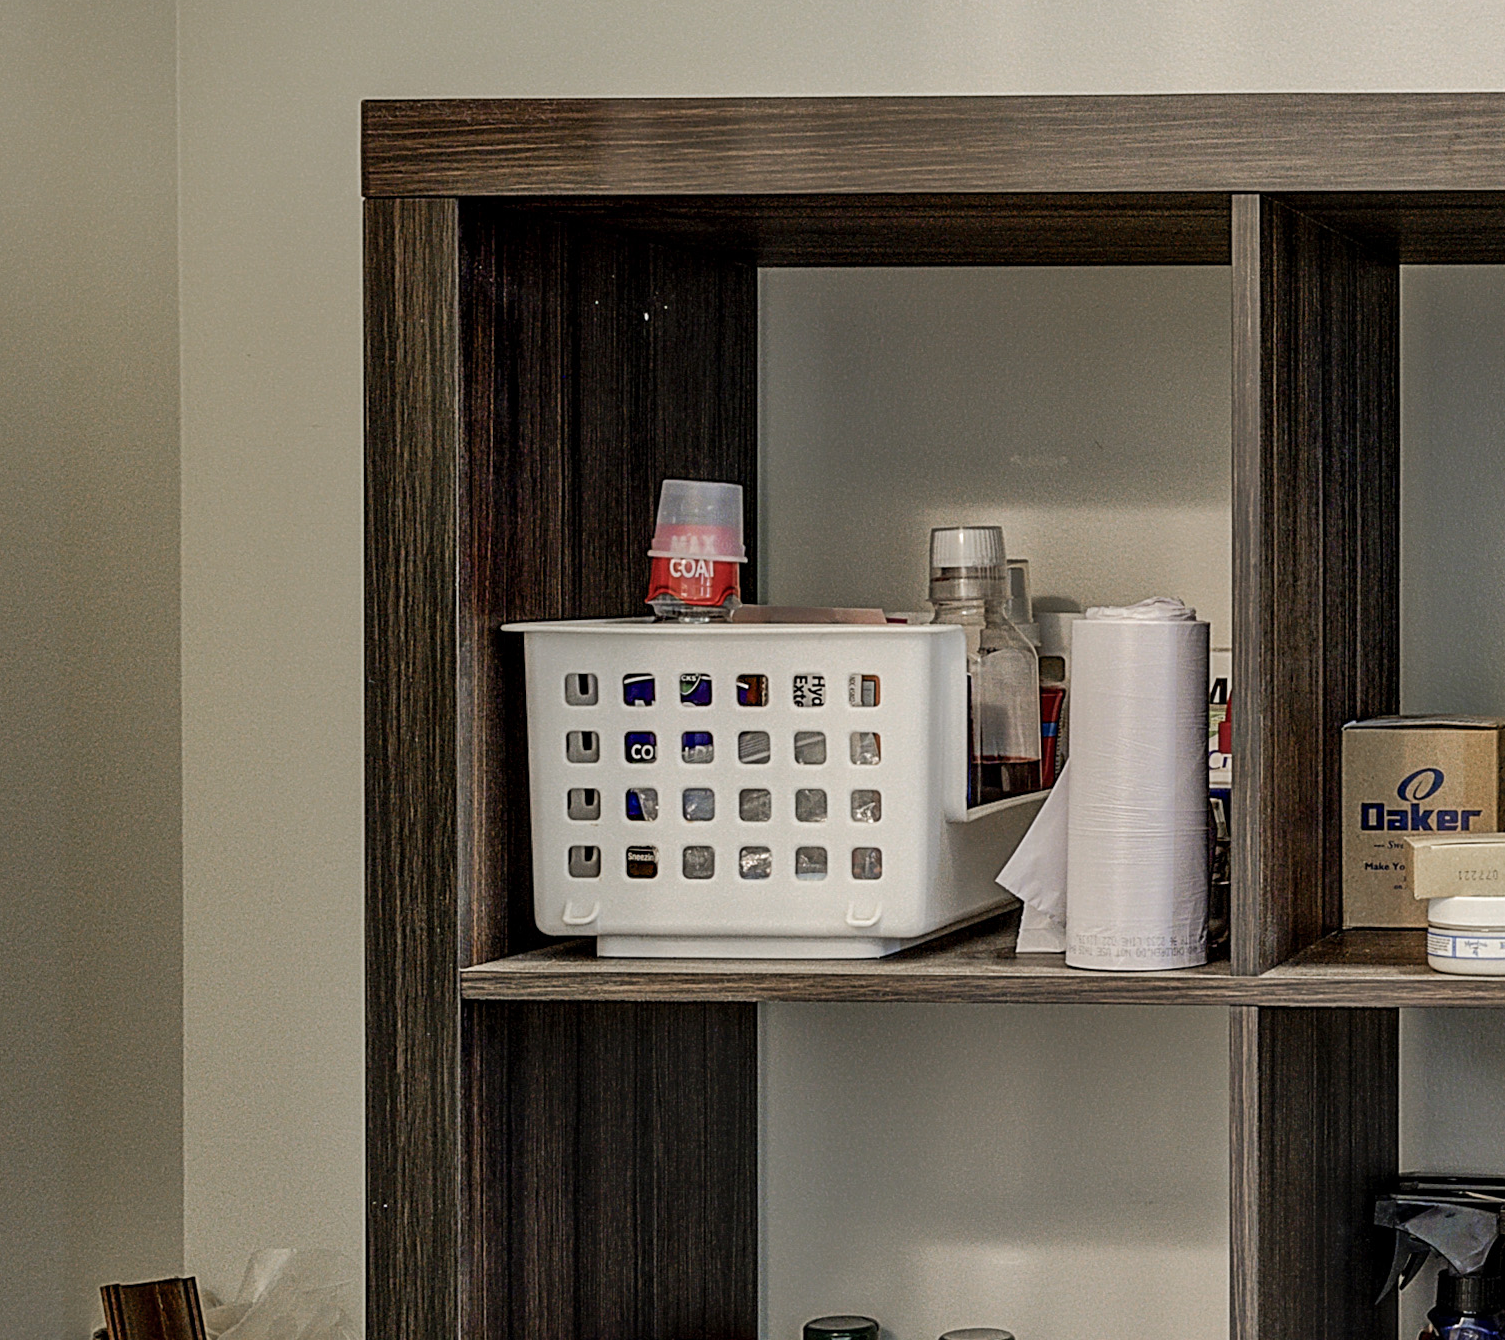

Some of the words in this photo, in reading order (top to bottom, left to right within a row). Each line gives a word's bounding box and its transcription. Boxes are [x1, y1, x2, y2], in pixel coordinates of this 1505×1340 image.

[807, 675, 825, 706] Hyd
[1361, 803, 1483, 831] Oaker
[1364, 862, 1389, 871] Make
[1391, 862, 1406, 871] Yo
